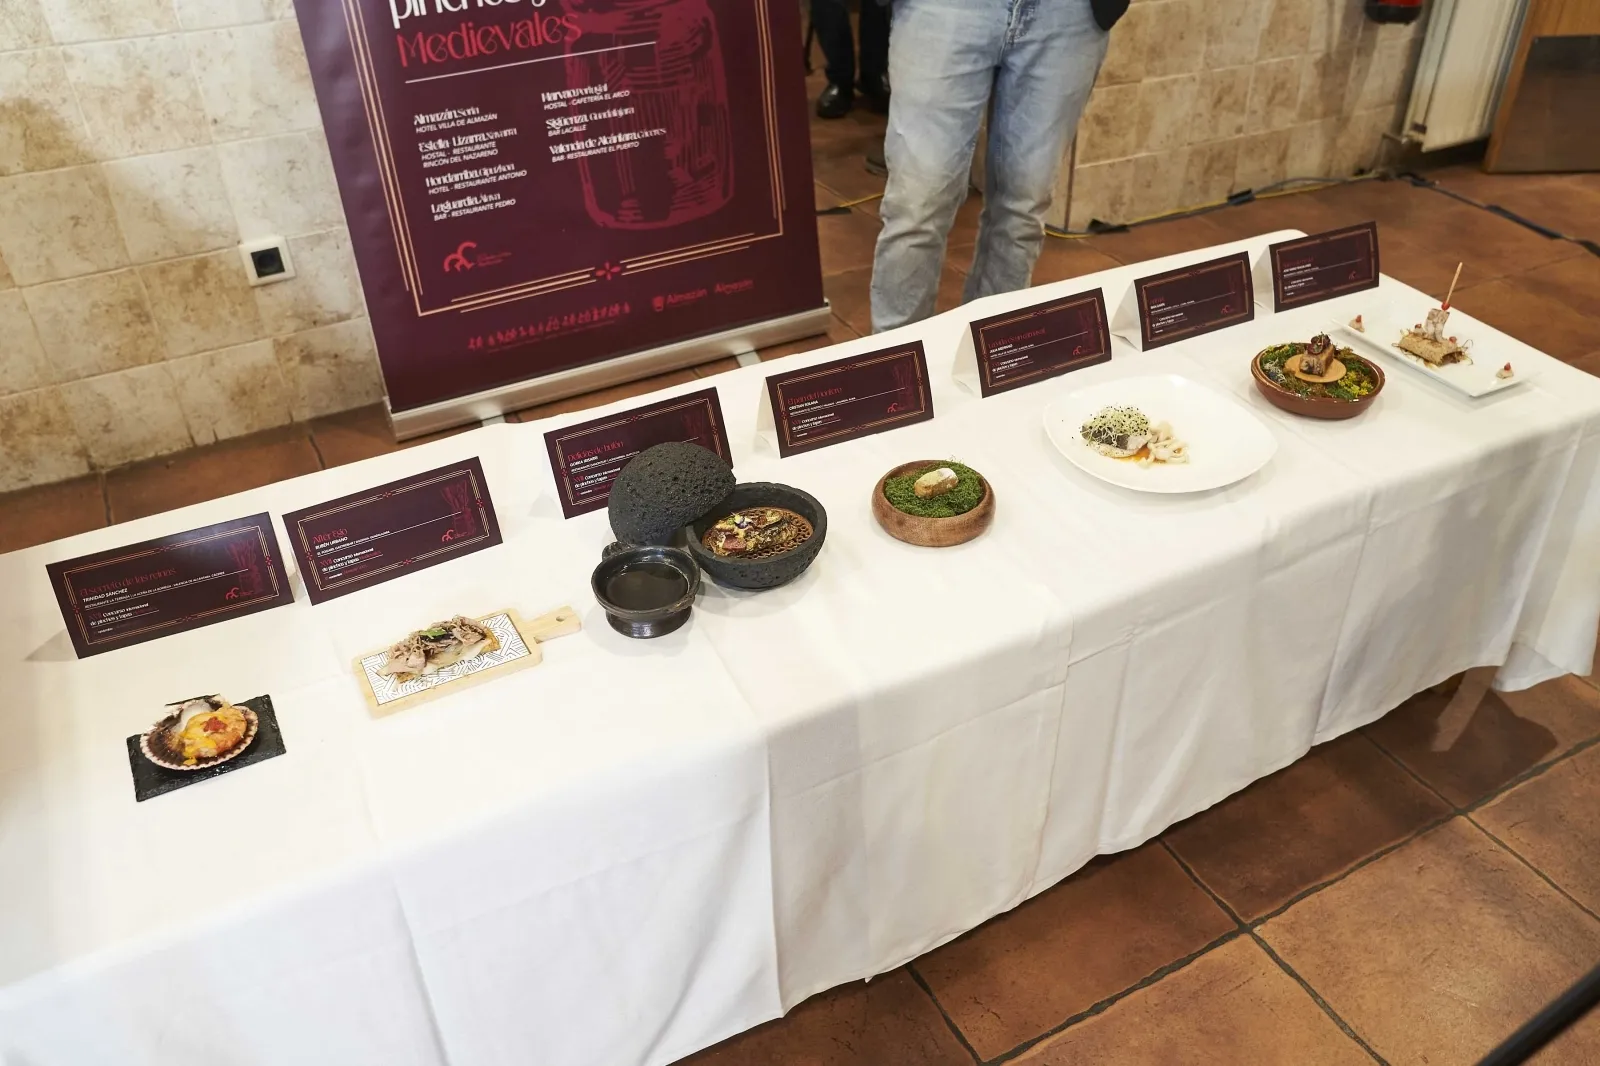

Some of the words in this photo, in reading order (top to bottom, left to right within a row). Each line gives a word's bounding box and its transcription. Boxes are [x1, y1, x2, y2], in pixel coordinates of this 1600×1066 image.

[396, 12, 582, 68] Medievales
[544, 101, 568, 110] HOSTAL
[612, 90, 630, 98] ARCO
[416, 122, 437, 133] HOTEL
[438, 120, 456, 130] VILLA
[466, 113, 498, 124] ALMAZÁN
[548, 128, 561, 137] BAR
[422, 150, 447, 160] HOSTAL
[452, 141, 496, 155] RESTAURANTE
[450, 154, 462, 164] DEL
[463, 149, 498, 160] NAZARENO
[567, 148, 608, 160] RESTAURANTE
[616, 142, 640, 152] PUERTO
[428, 184, 450, 195] HOTEL
[454, 174, 496, 190] RESTAURANTE
[498, 170, 528, 181] ANTONIO
[434, 212, 448, 221] BAR
[451, 202, 494, 217] RESTAURANTE
[495, 198, 516, 208] PEDRO
[82, 594, 105, 602] TRINIDAD
